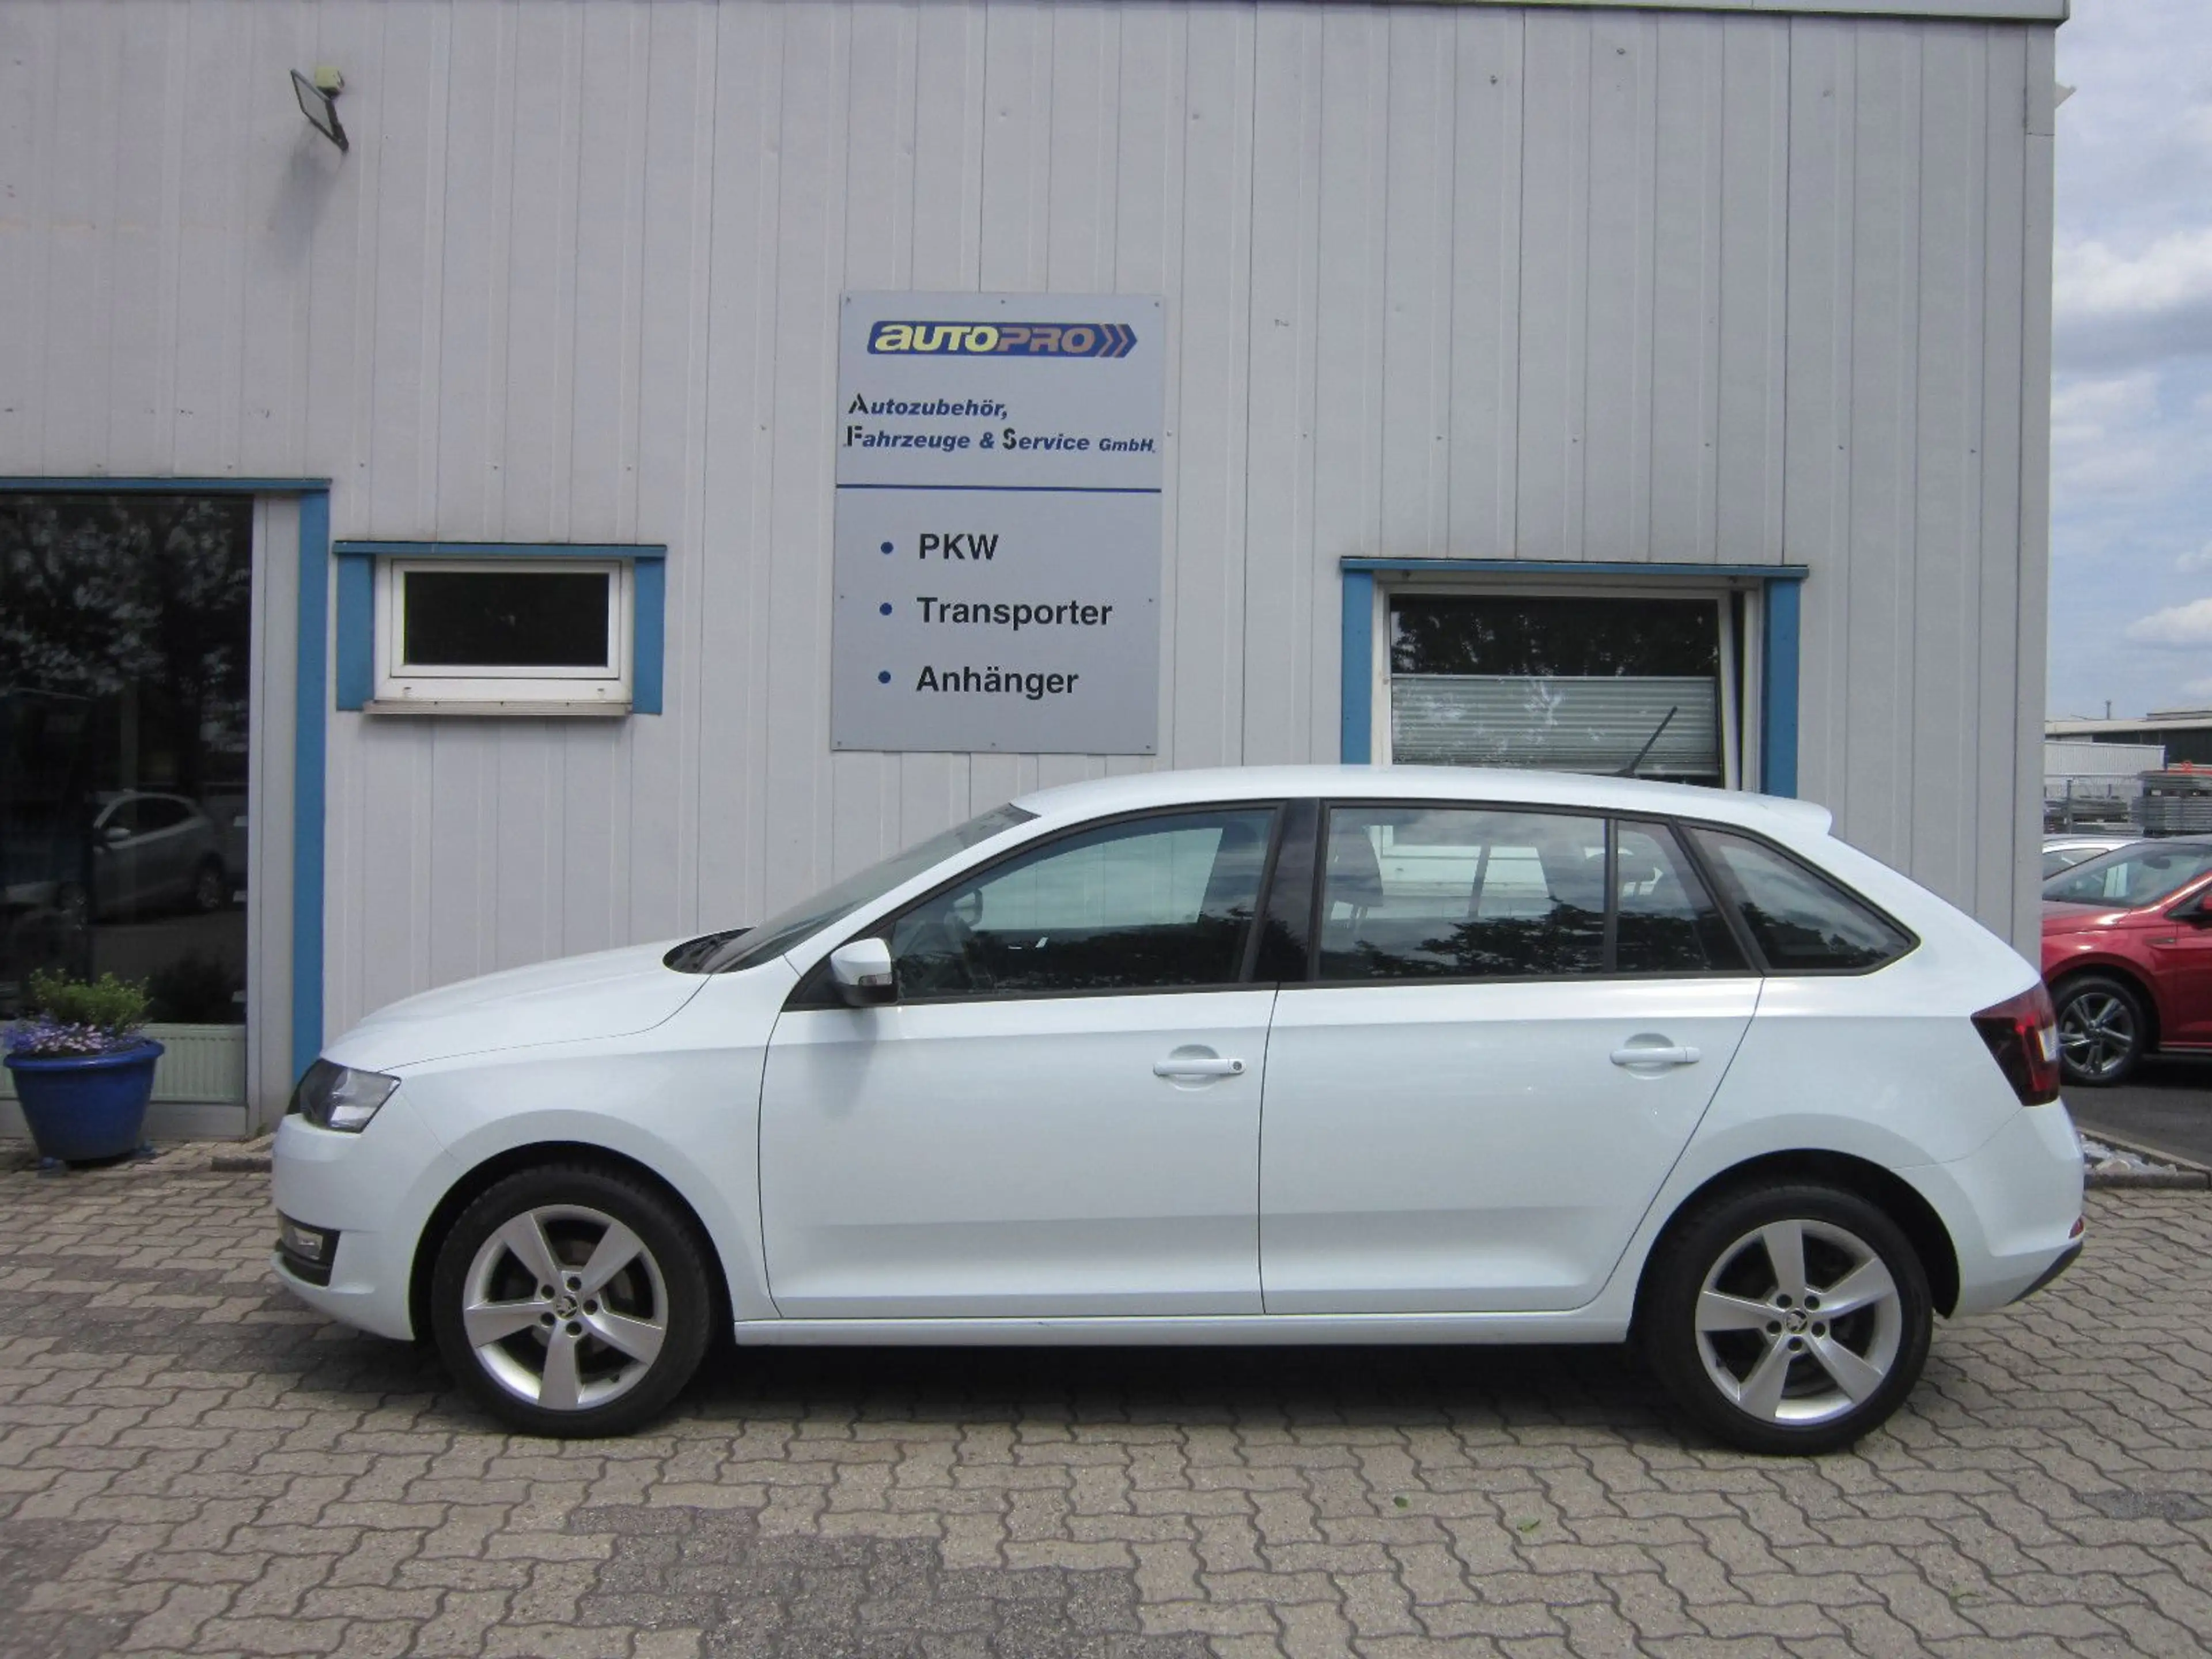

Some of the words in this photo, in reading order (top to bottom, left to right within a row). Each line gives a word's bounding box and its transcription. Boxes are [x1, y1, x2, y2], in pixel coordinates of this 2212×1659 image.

[849, 393, 1008, 419] Autozubehör,
[847, 426, 970, 452] Fahrzeuge
[980, 433, 995, 449] &
[1002, 429, 1090, 451] Service
[919, 533, 999, 560] PKW
[916, 597, 1112, 631] Transporter
[916, 666, 1079, 700] Anhänger
